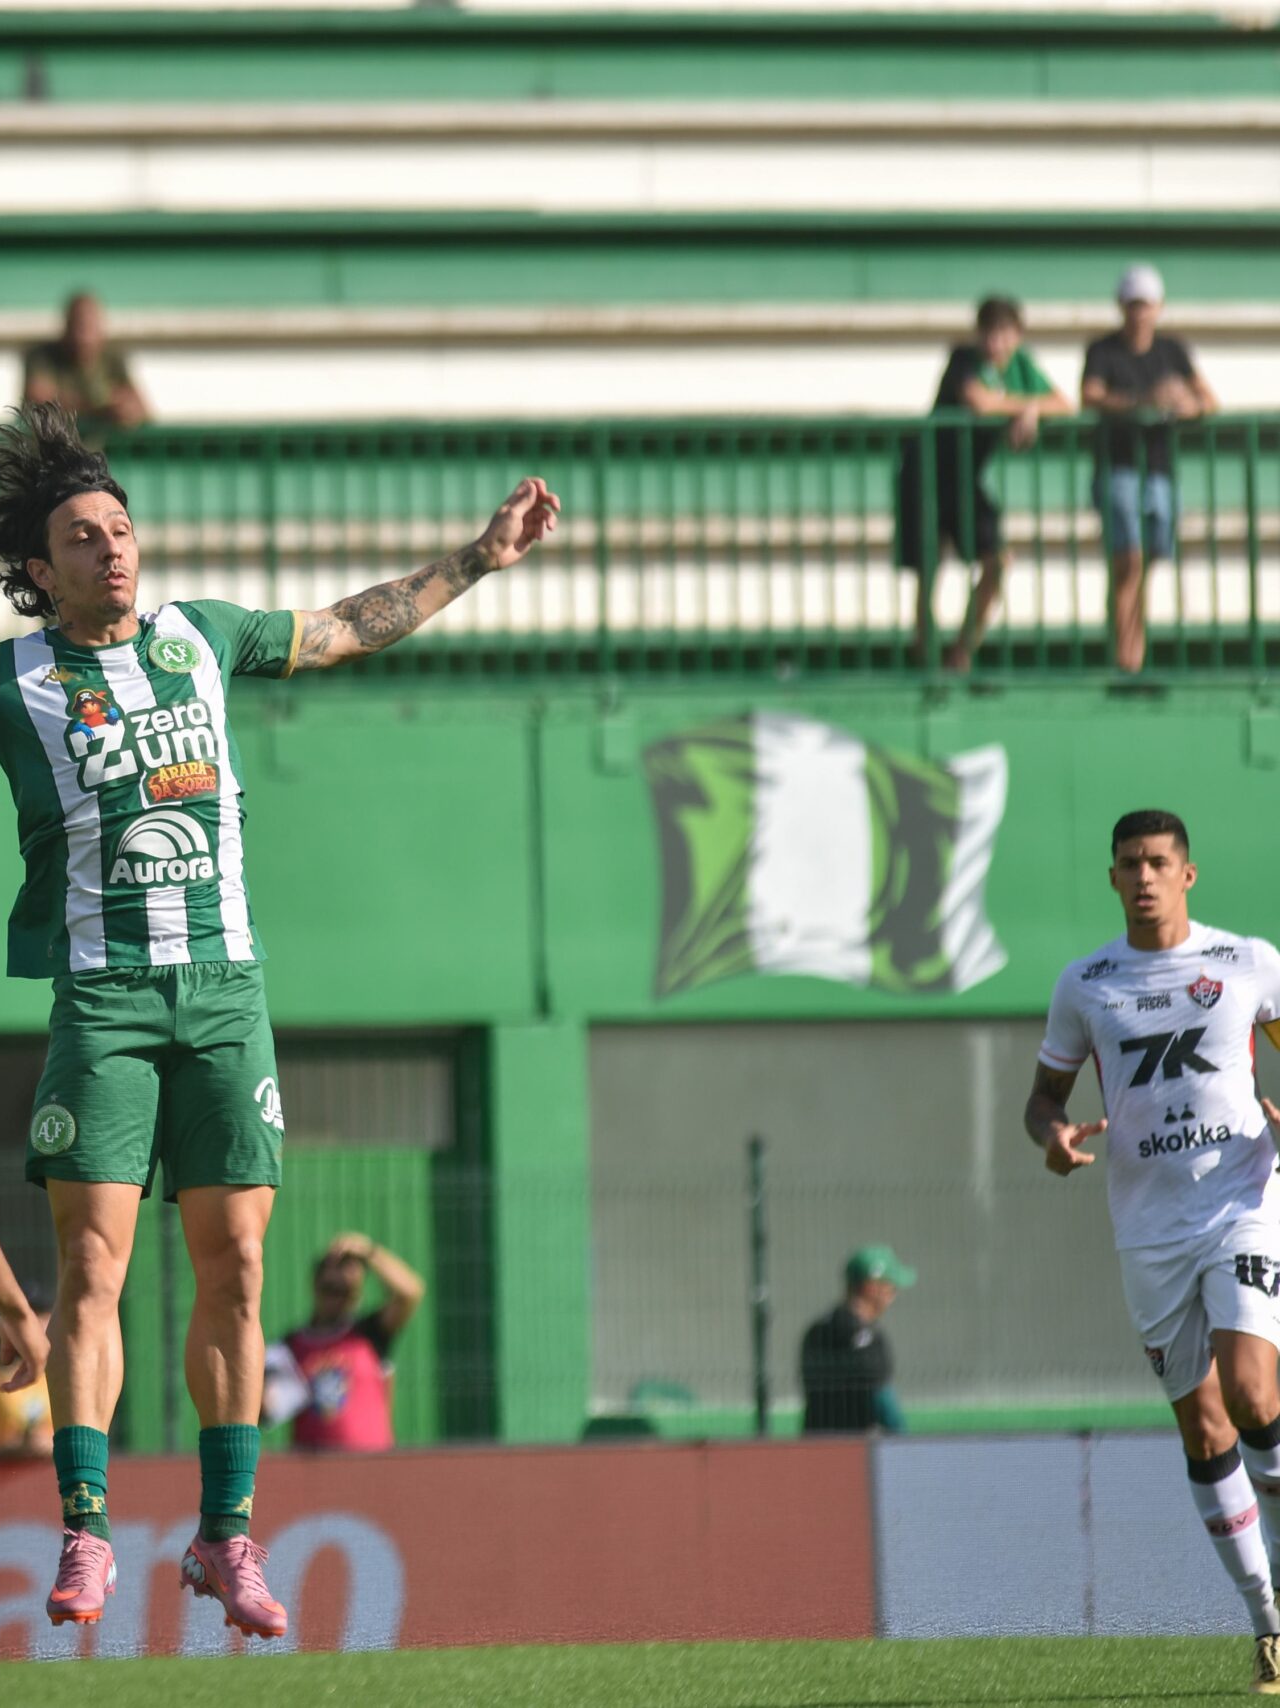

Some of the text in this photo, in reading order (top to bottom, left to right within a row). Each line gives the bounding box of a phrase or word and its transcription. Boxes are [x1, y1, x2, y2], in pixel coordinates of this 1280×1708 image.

[131, 702, 208, 738] zero
[137, 725, 215, 769] um
[159, 760, 207, 783] ARARA
[174, 777, 217, 799] SORTE
[109, 856, 215, 884] Aurora
[1119, 1026, 1221, 1089] 7K
[1138, 1123, 1232, 1159] skokka
